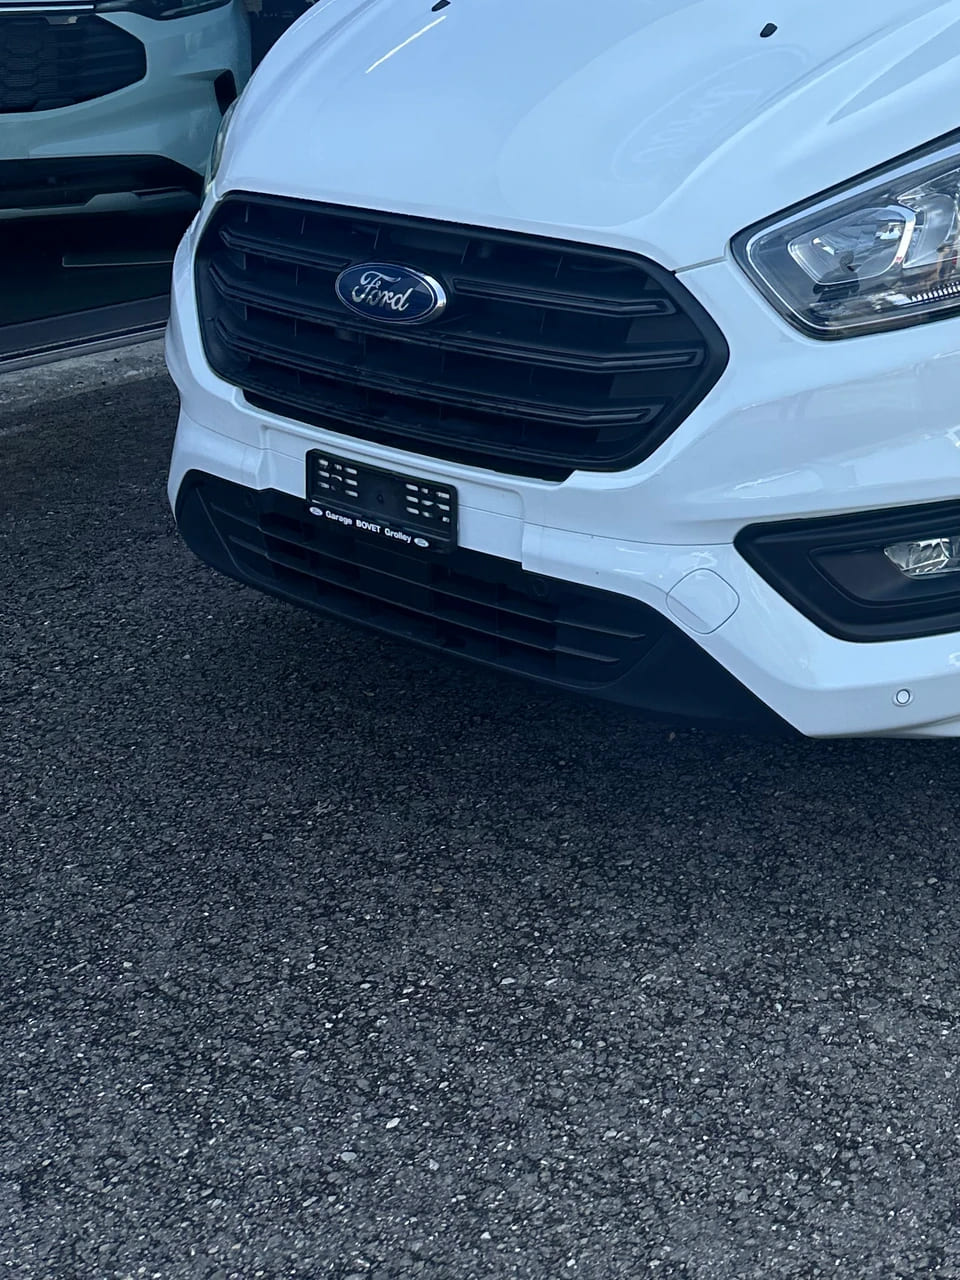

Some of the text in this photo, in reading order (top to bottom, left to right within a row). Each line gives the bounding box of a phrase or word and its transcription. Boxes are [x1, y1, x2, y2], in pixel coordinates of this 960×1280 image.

[351, 270, 414, 312] Ford
[325, 510, 353, 526] Garage
[356, 519, 381, 534] BOVET
[384, 528, 412, 544] Grolley
